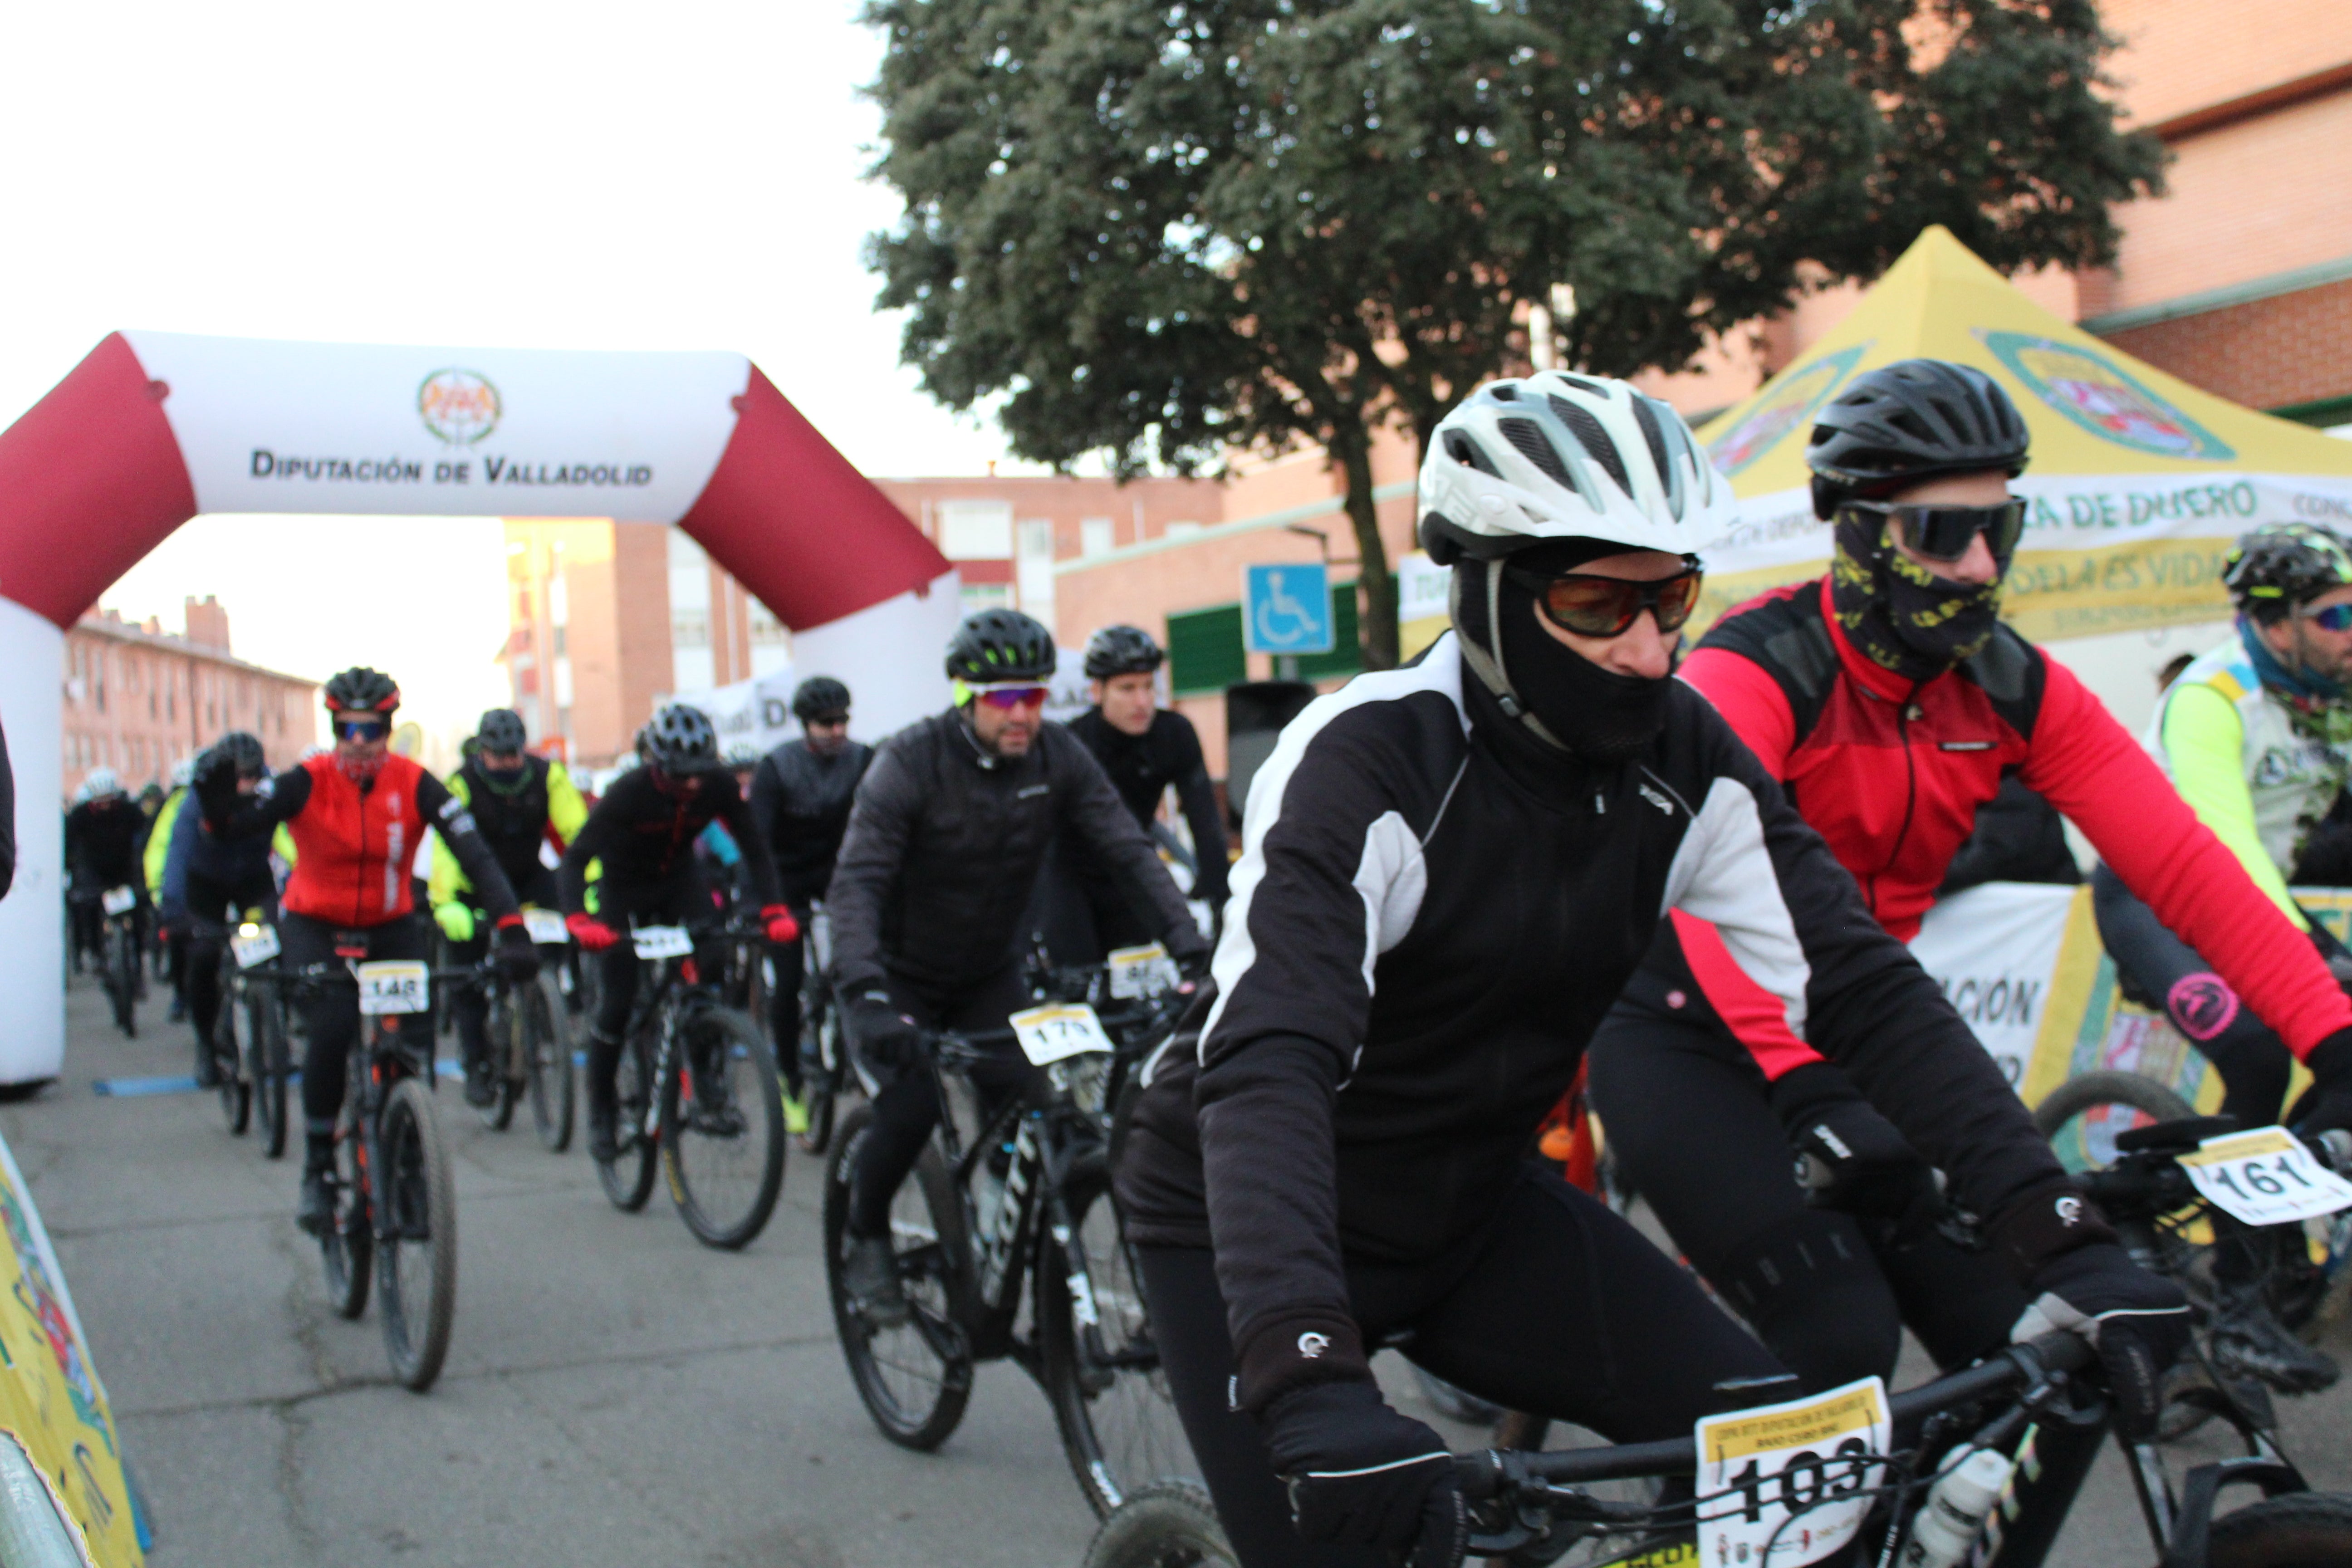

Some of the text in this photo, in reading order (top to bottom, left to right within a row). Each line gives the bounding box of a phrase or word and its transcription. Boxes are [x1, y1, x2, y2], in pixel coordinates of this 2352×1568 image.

[250, 449, 652, 485] DIPUTACIÓN DE VALLADOLID
[2066, 494, 2118, 528] DE
[2128, 480, 2258, 526] DUERO
[2216, 1156, 2312, 1200] 161
[1731, 1437, 1865, 1524] 103
